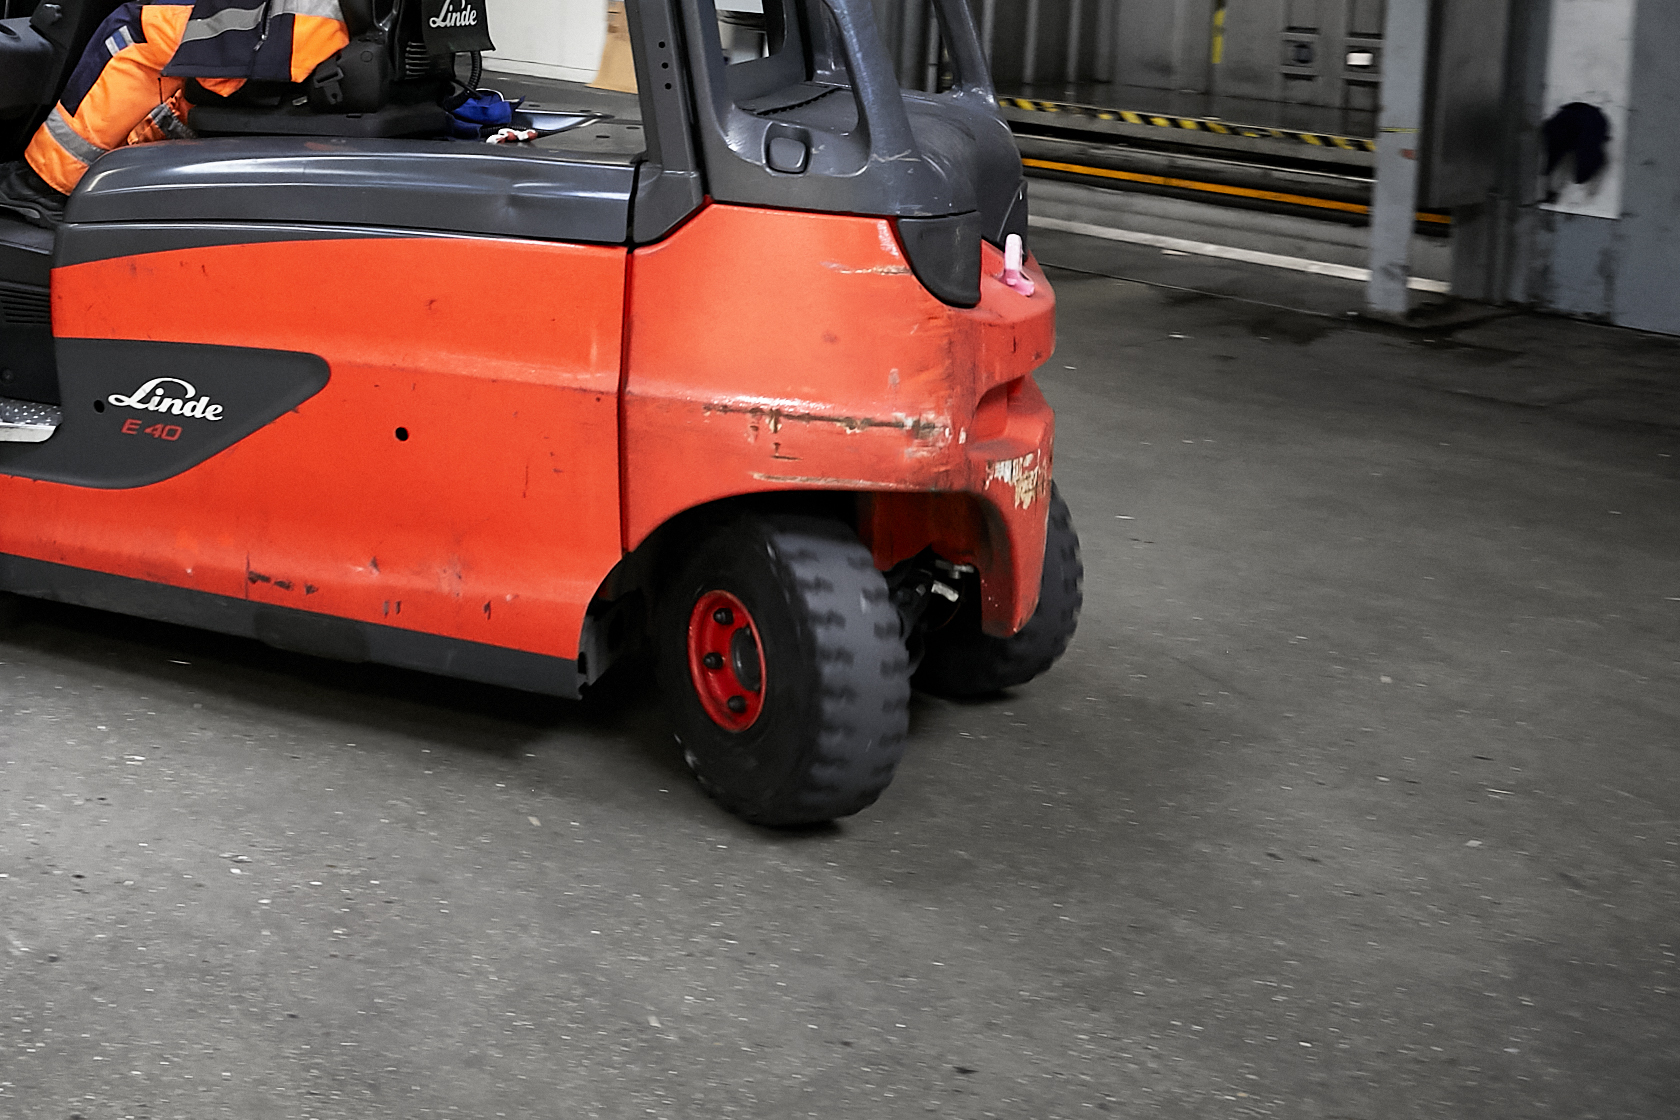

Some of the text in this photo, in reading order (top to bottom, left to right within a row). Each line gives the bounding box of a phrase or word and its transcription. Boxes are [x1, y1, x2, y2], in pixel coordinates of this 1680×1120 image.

[108, 377, 223, 421] Linde
[121, 418, 183, 441] E 40
